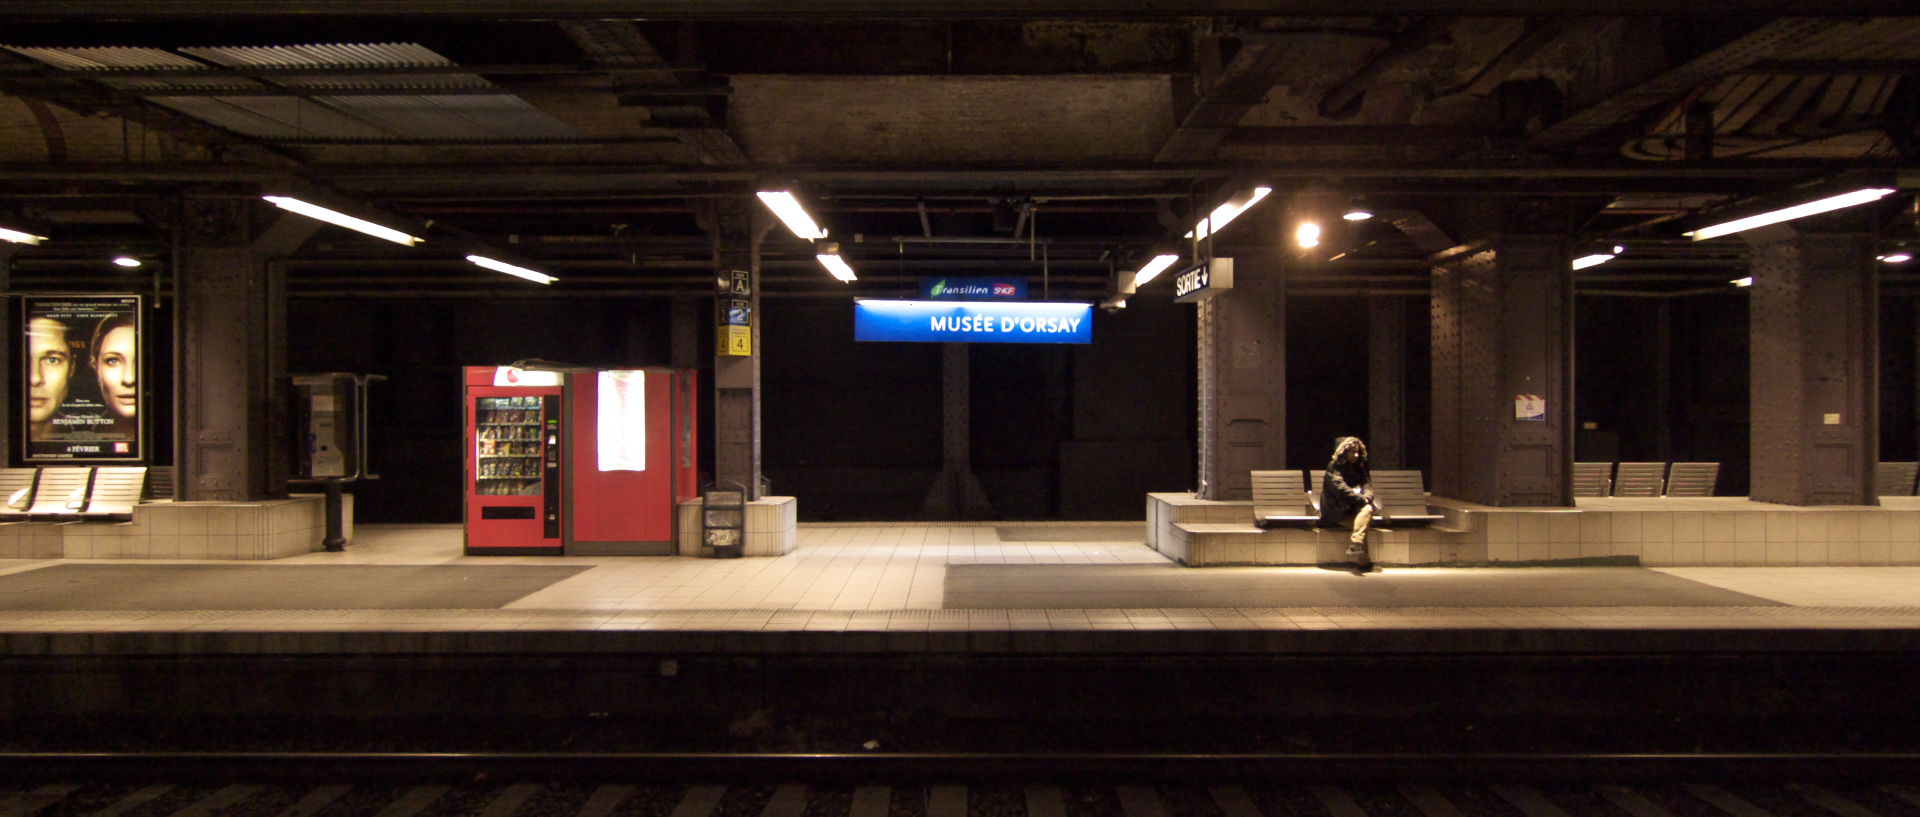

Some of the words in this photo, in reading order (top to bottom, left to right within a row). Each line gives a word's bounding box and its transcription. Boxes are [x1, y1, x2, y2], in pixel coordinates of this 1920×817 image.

[736, 279, 745, 292] A
[1177, 268, 1201, 296] SORTIE
[935, 284, 989, 294] Transilien
[736, 309, 744, 321] 2
[930, 313, 994, 332] MUSÉE
[1001, 317, 1081, 333] D'ORSAY
[736, 338, 744, 349] 4
